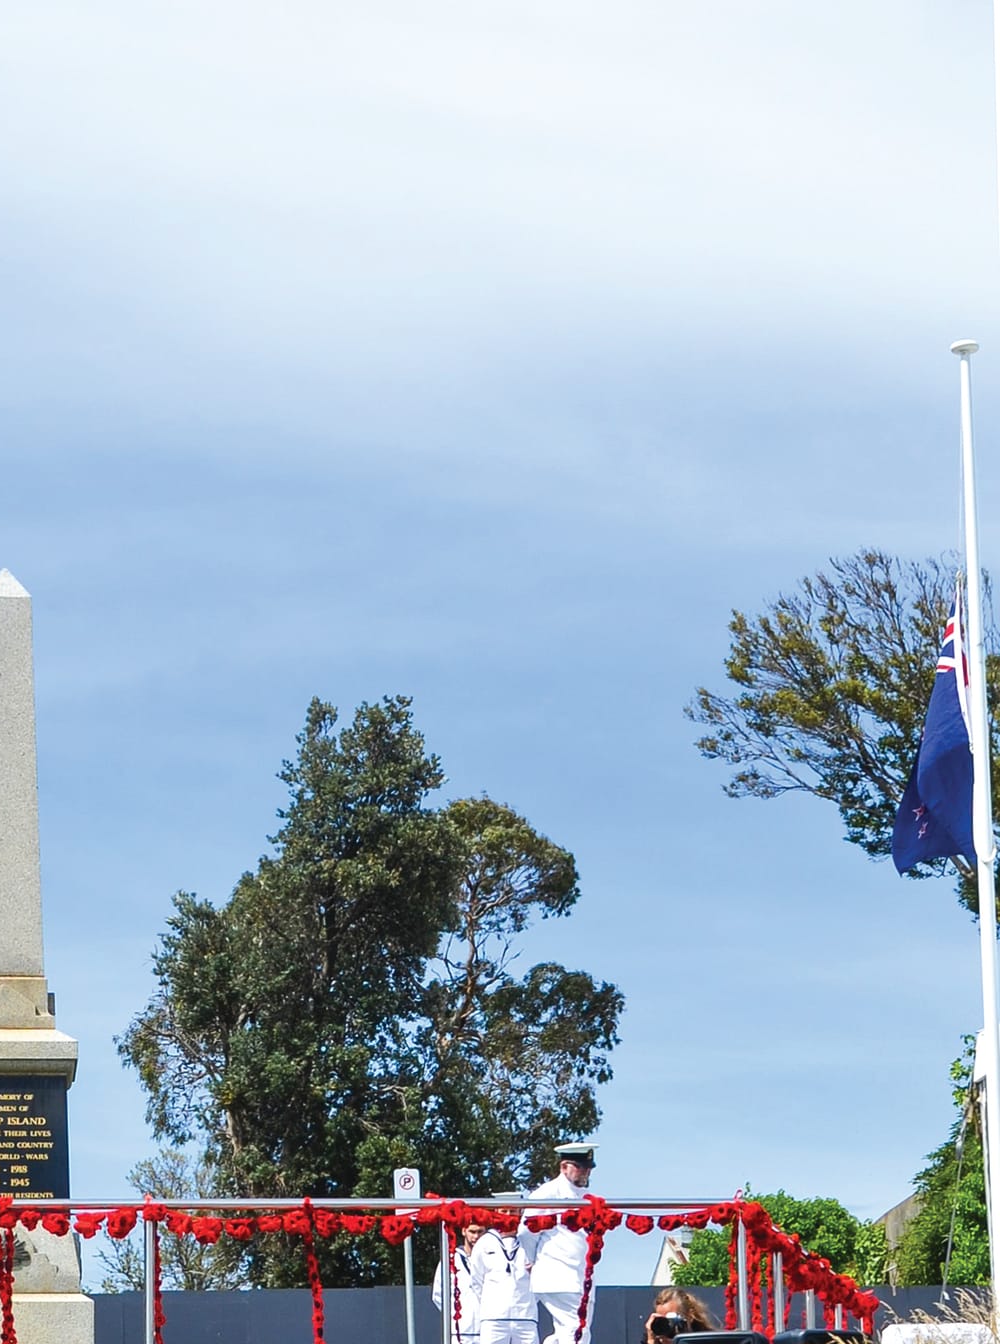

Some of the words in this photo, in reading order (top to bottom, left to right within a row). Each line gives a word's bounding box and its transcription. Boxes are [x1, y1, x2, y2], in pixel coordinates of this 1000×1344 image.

[7, 1117, 47, 1126] ISLAND
[11, 1165, 28, 1174] 1918
[10, 1178, 30, 1187] 1945
